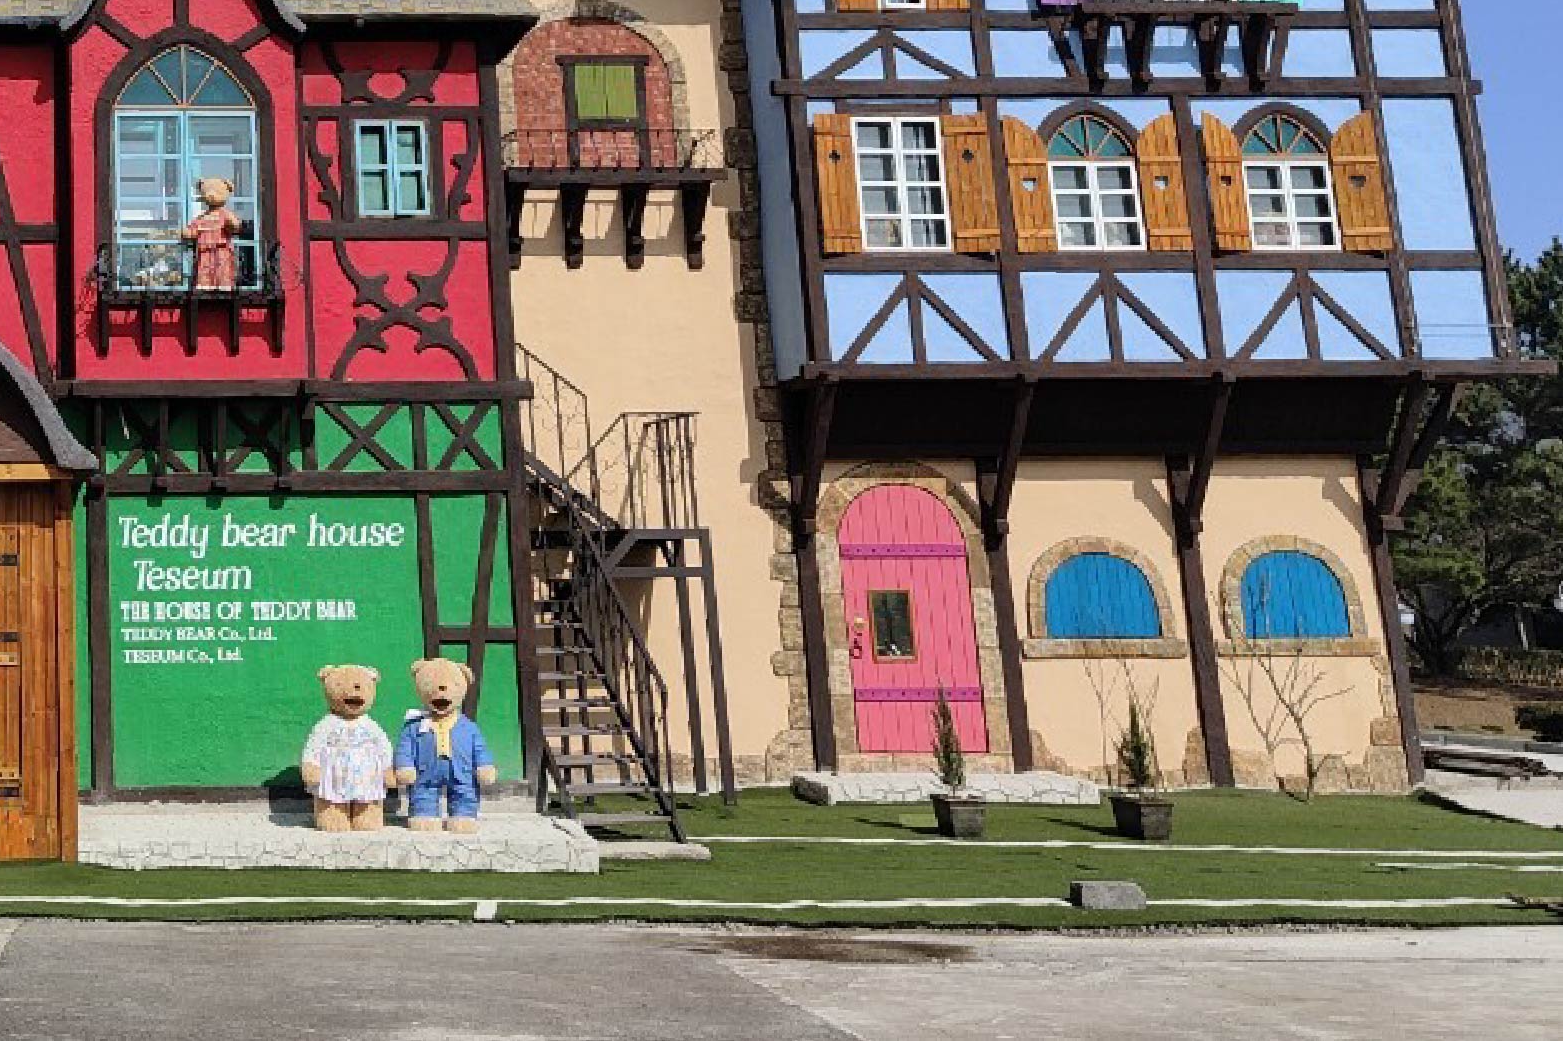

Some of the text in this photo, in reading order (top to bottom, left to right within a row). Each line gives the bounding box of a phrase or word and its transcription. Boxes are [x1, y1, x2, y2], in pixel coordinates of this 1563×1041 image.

[118, 513, 405, 559] Teddy bear house
[133, 560, 252, 591] Teseum
[120, 601, 358, 622] THE HOUSE OF TEDDY BEAR
[120, 627, 173, 641] TEDDY
[175, 627, 216, 641] BEAR
[248, 626, 277, 641] Ltd.
[123, 649, 186, 664] TESEUM
